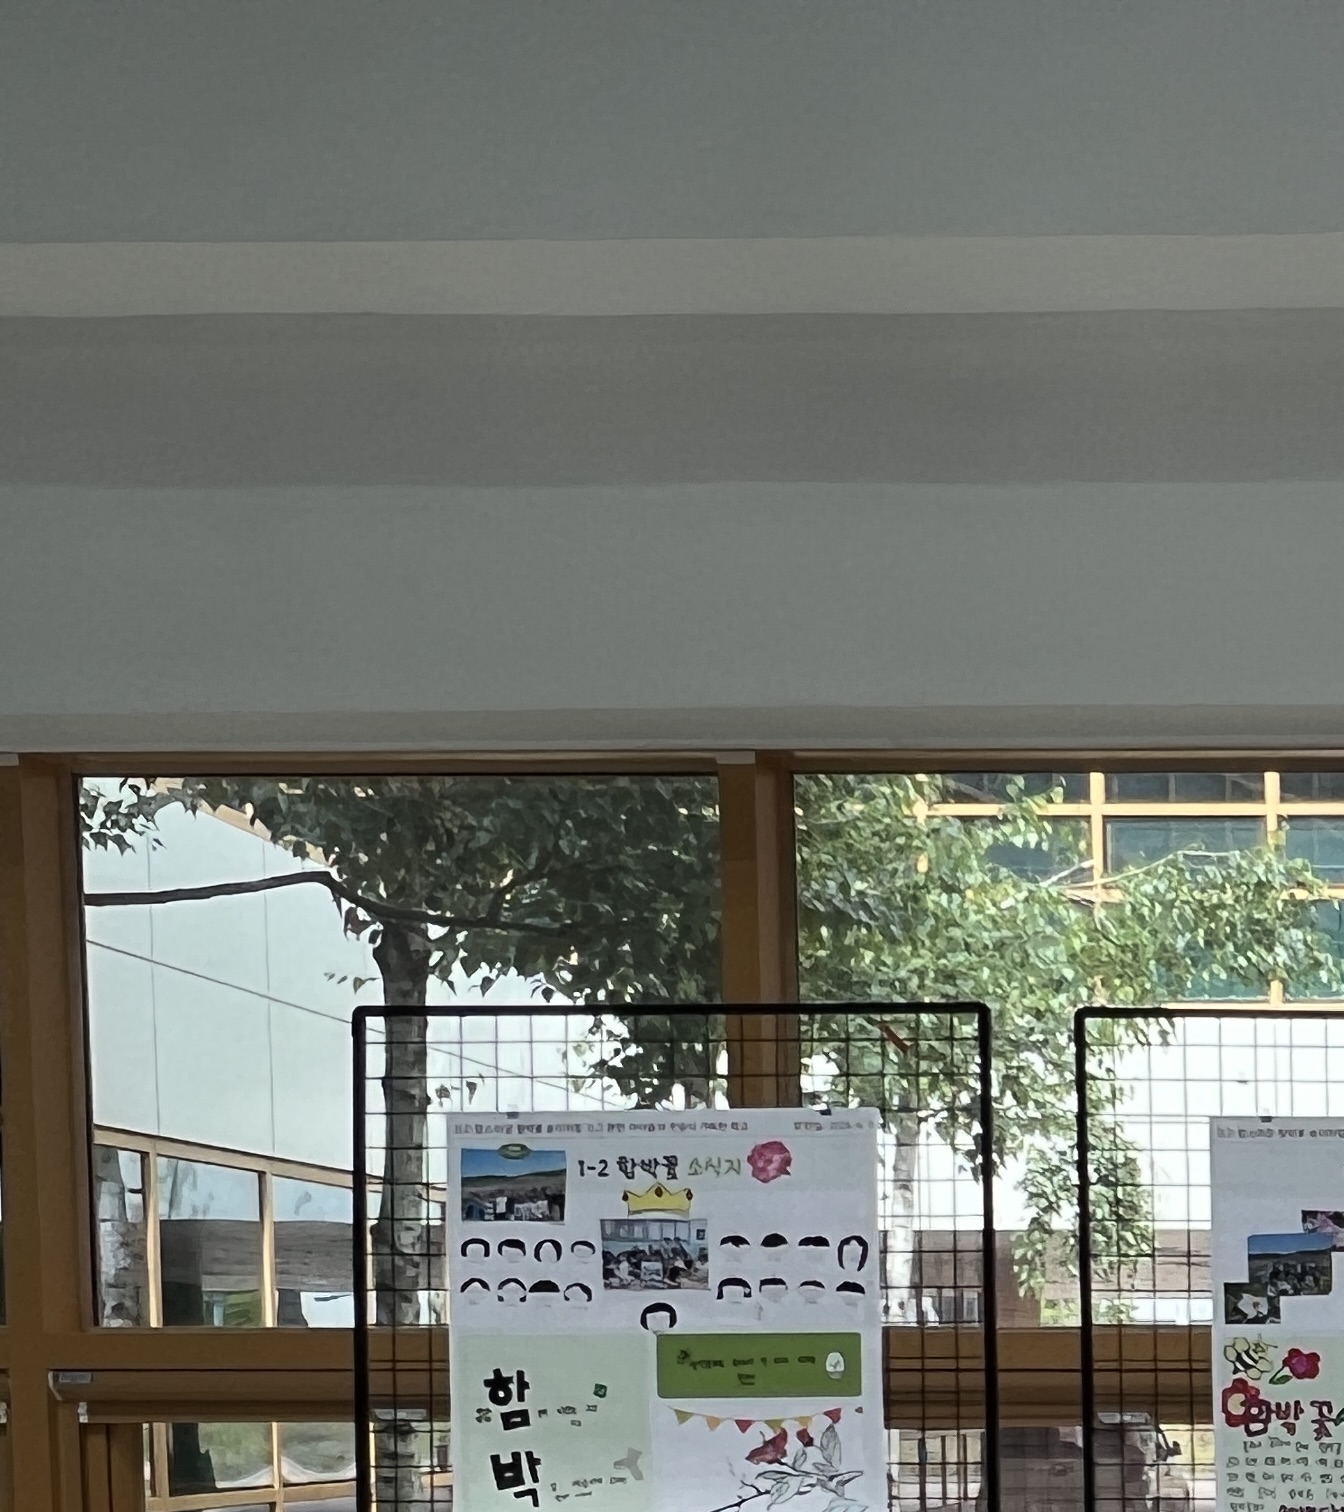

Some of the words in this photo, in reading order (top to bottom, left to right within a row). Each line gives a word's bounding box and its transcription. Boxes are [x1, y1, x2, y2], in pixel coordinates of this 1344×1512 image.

[578, 1158, 609, 1178] 1-2
[616, 1154, 679, 1181] 함박꽃
[687, 1155, 742, 1178] 소식지
